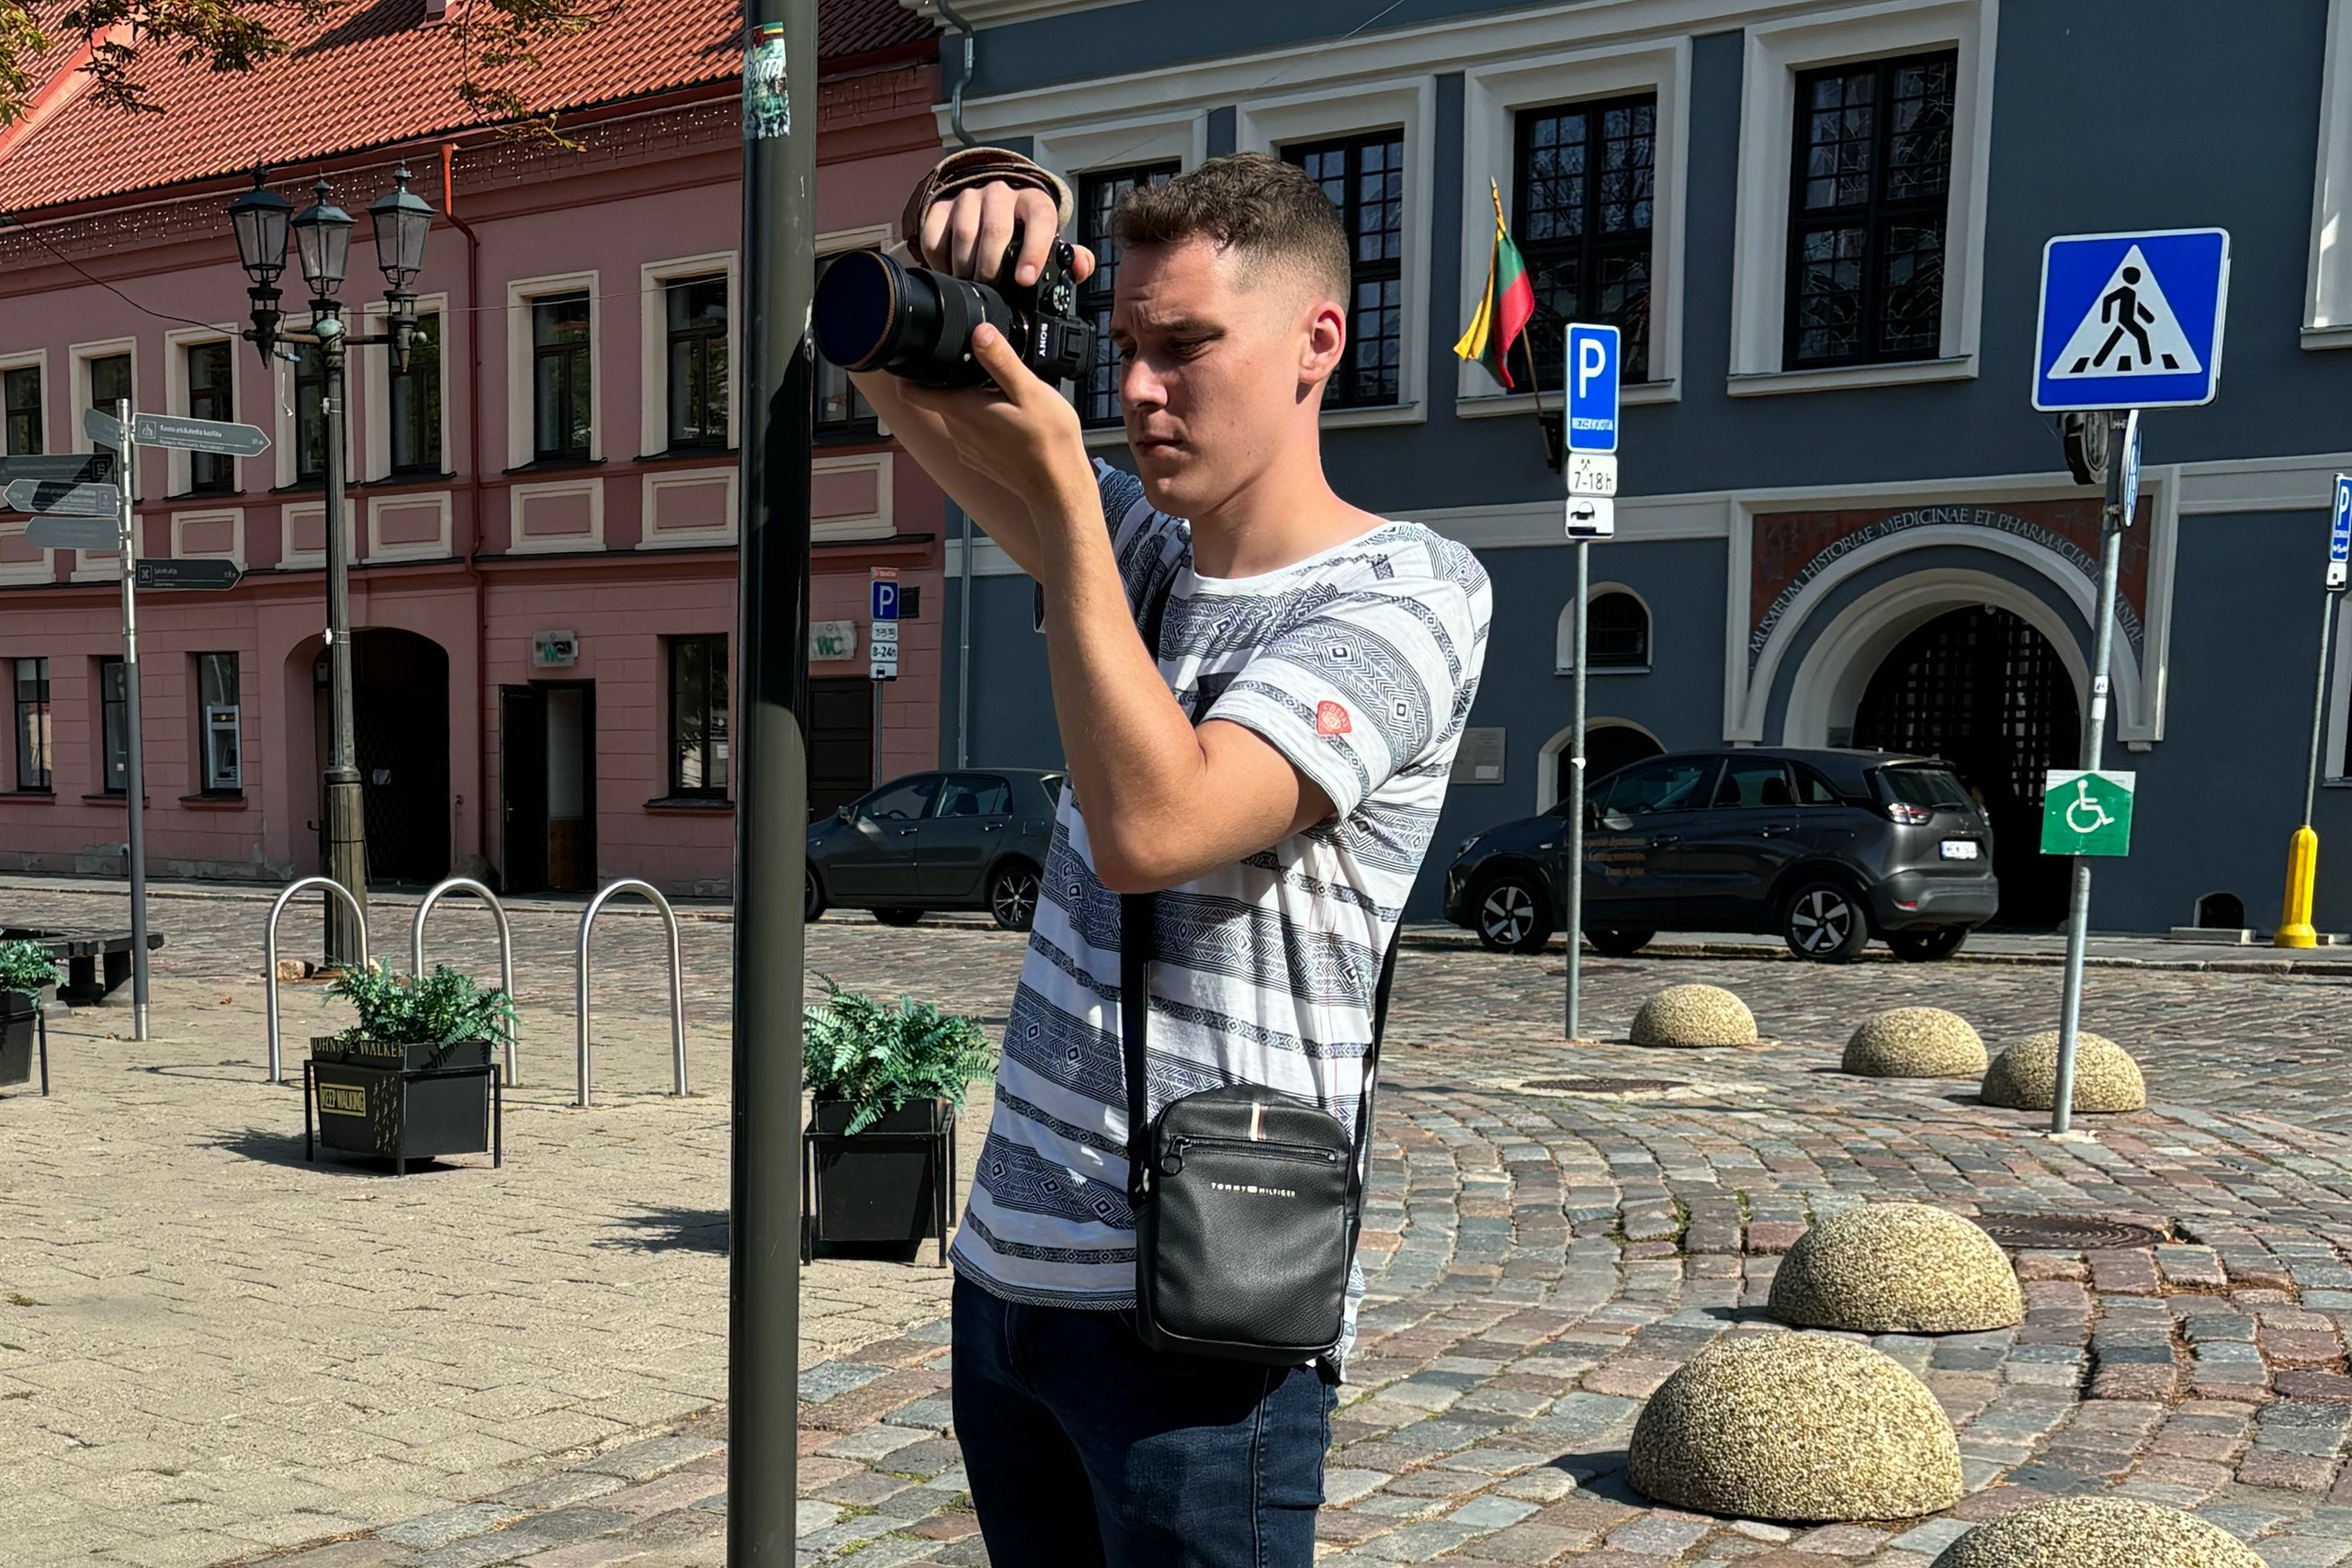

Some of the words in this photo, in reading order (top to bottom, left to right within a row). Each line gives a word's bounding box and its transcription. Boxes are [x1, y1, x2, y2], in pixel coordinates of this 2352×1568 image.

[1039, 323, 1048, 356] SONY
[1578, 338, 1606, 399] P
[2337, 485, 2350, 526] P
[1748, 580, 1804, 653] MUSAEUM
[1802, 525, 1877, 582] HISTORIAE
[1879, 508, 1968, 536] MEDICINAE
[1975, 510, 1995, 525] ET
[1997, 513, 2094, 574] PHARMACIAE
[879, 584, 895, 616] P
[817, 636, 845, 656] WC
[359, 1041, 404, 1057] WALKER
[336, 1089, 365, 1111] WALKING
[1211, 1182, 1246, 1192] TOMMY
[1259, 1188, 1295, 1197] HILFIGER
